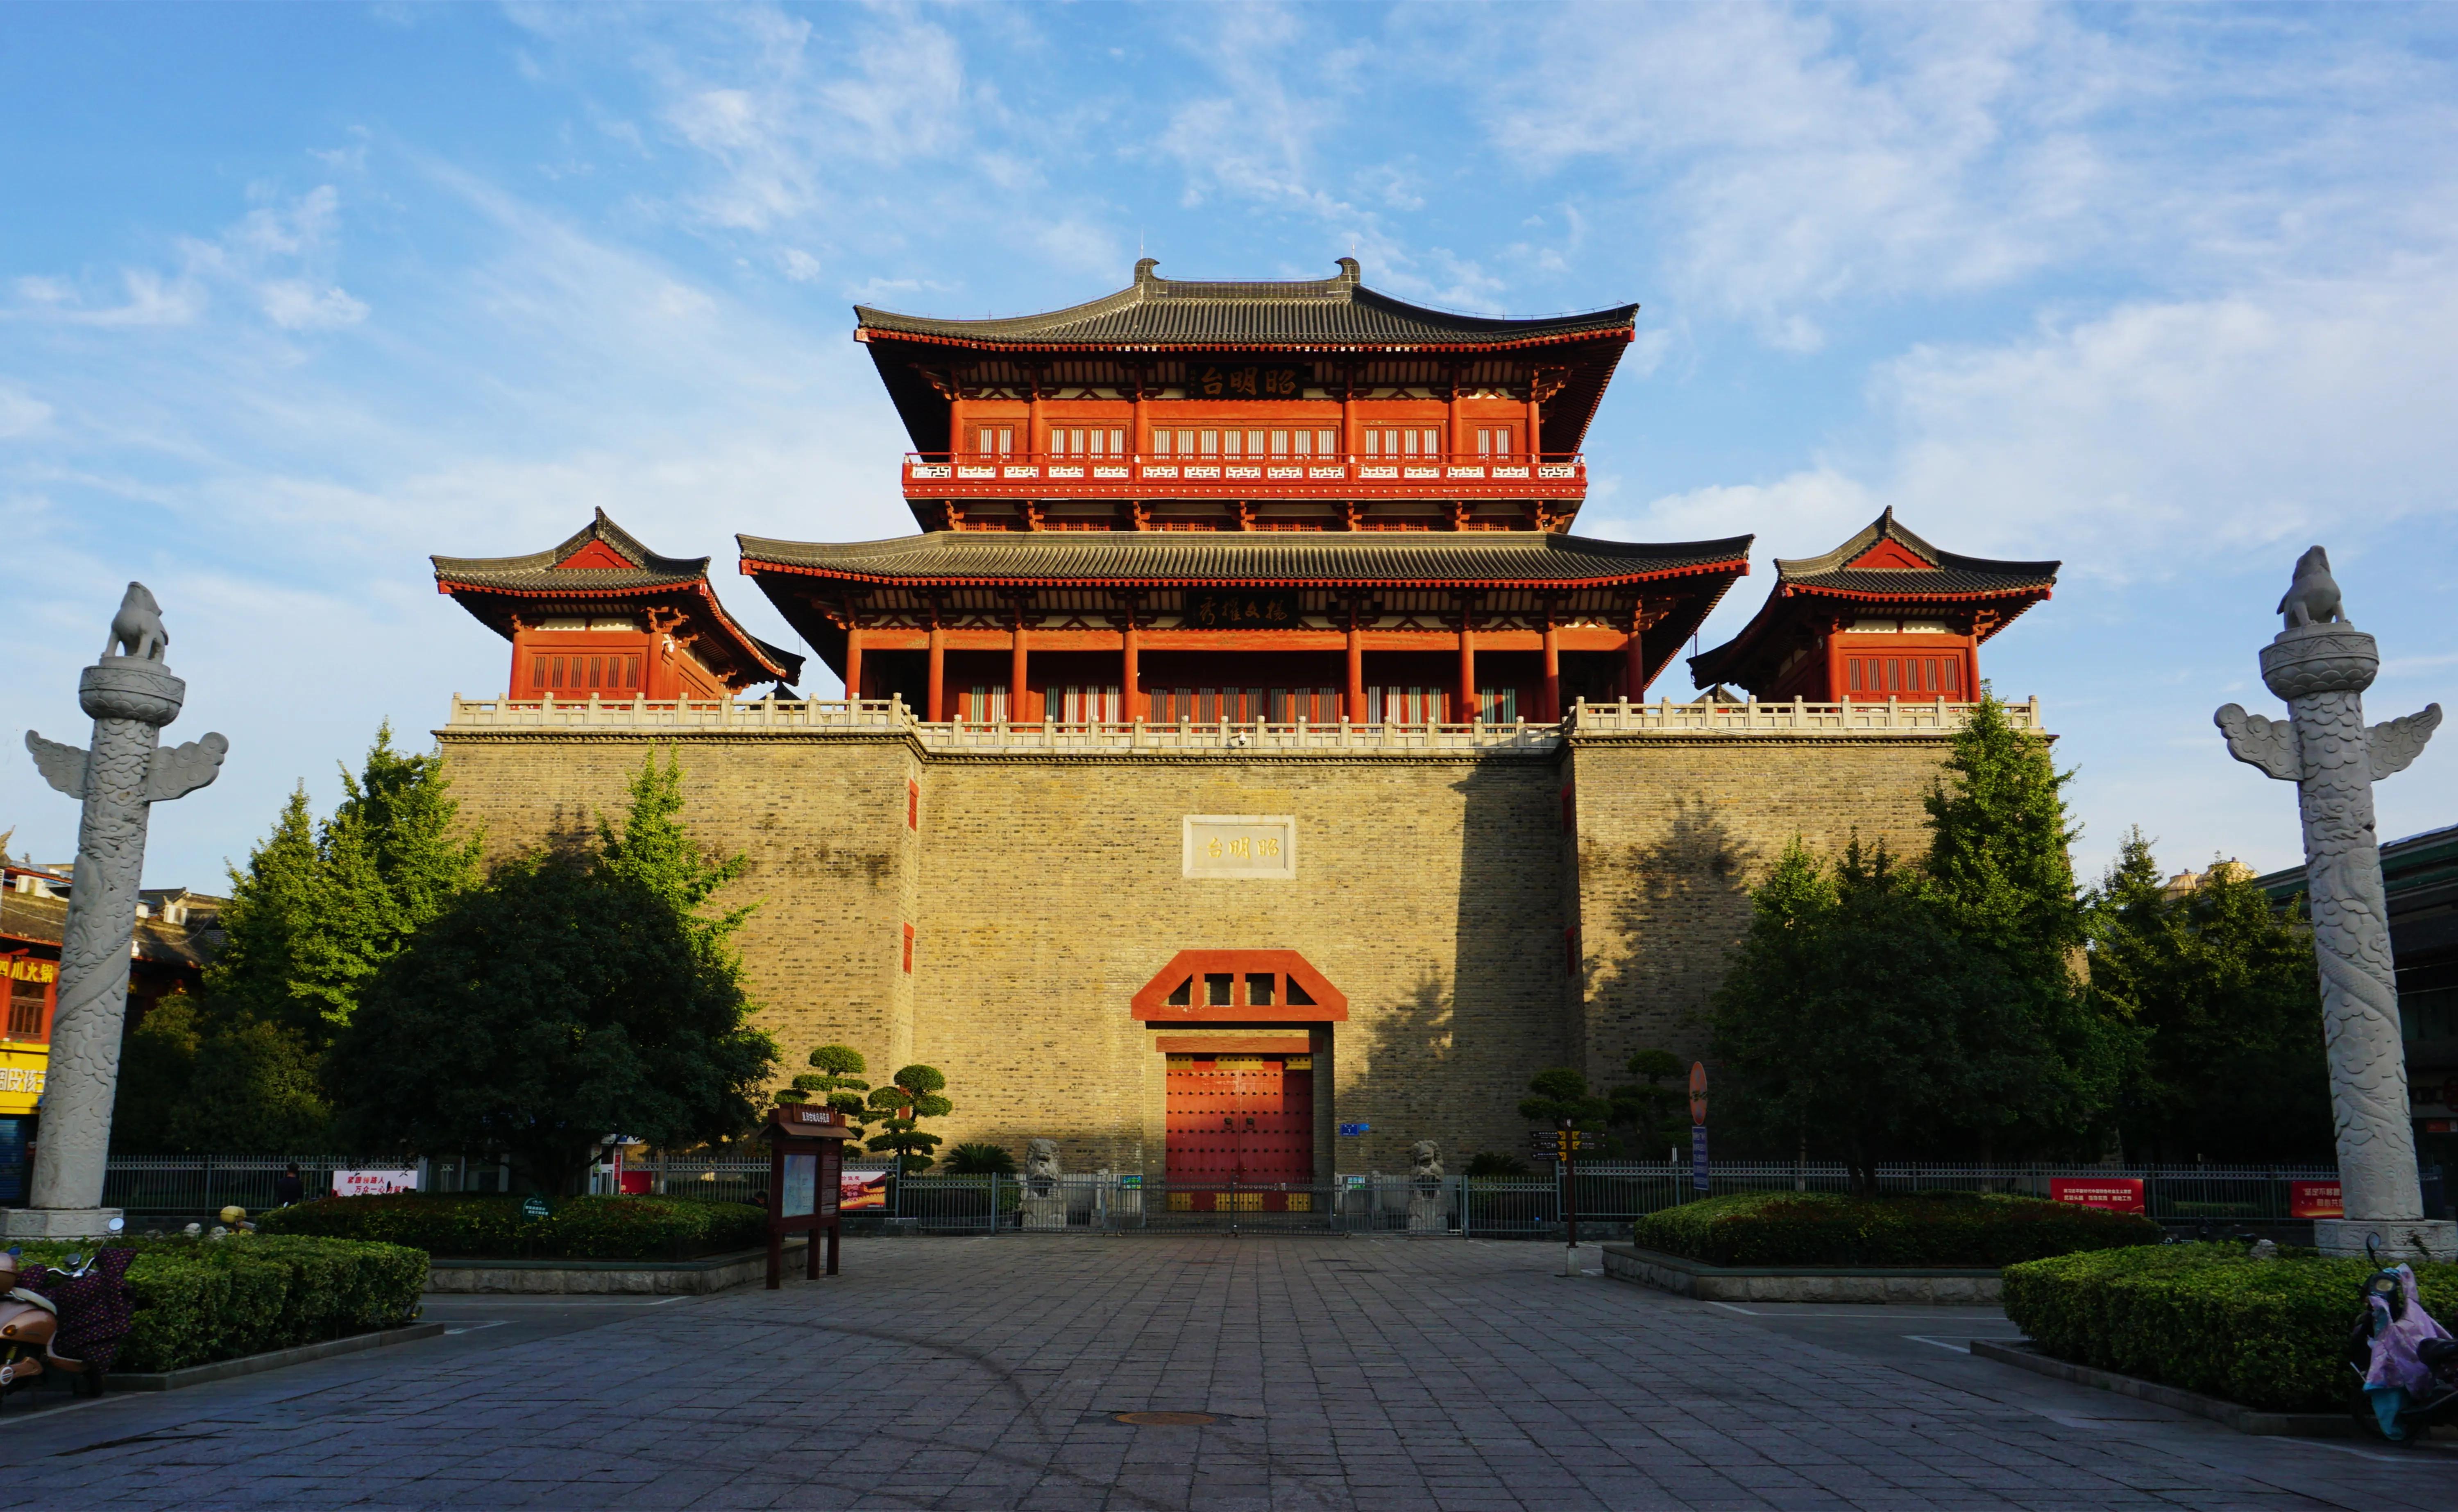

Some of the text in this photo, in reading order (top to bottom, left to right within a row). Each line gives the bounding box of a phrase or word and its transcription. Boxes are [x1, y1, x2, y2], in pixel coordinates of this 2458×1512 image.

[1206, 836, 1279, 860] 昭明台
[0, 960, 53, 983] 四川火锅
